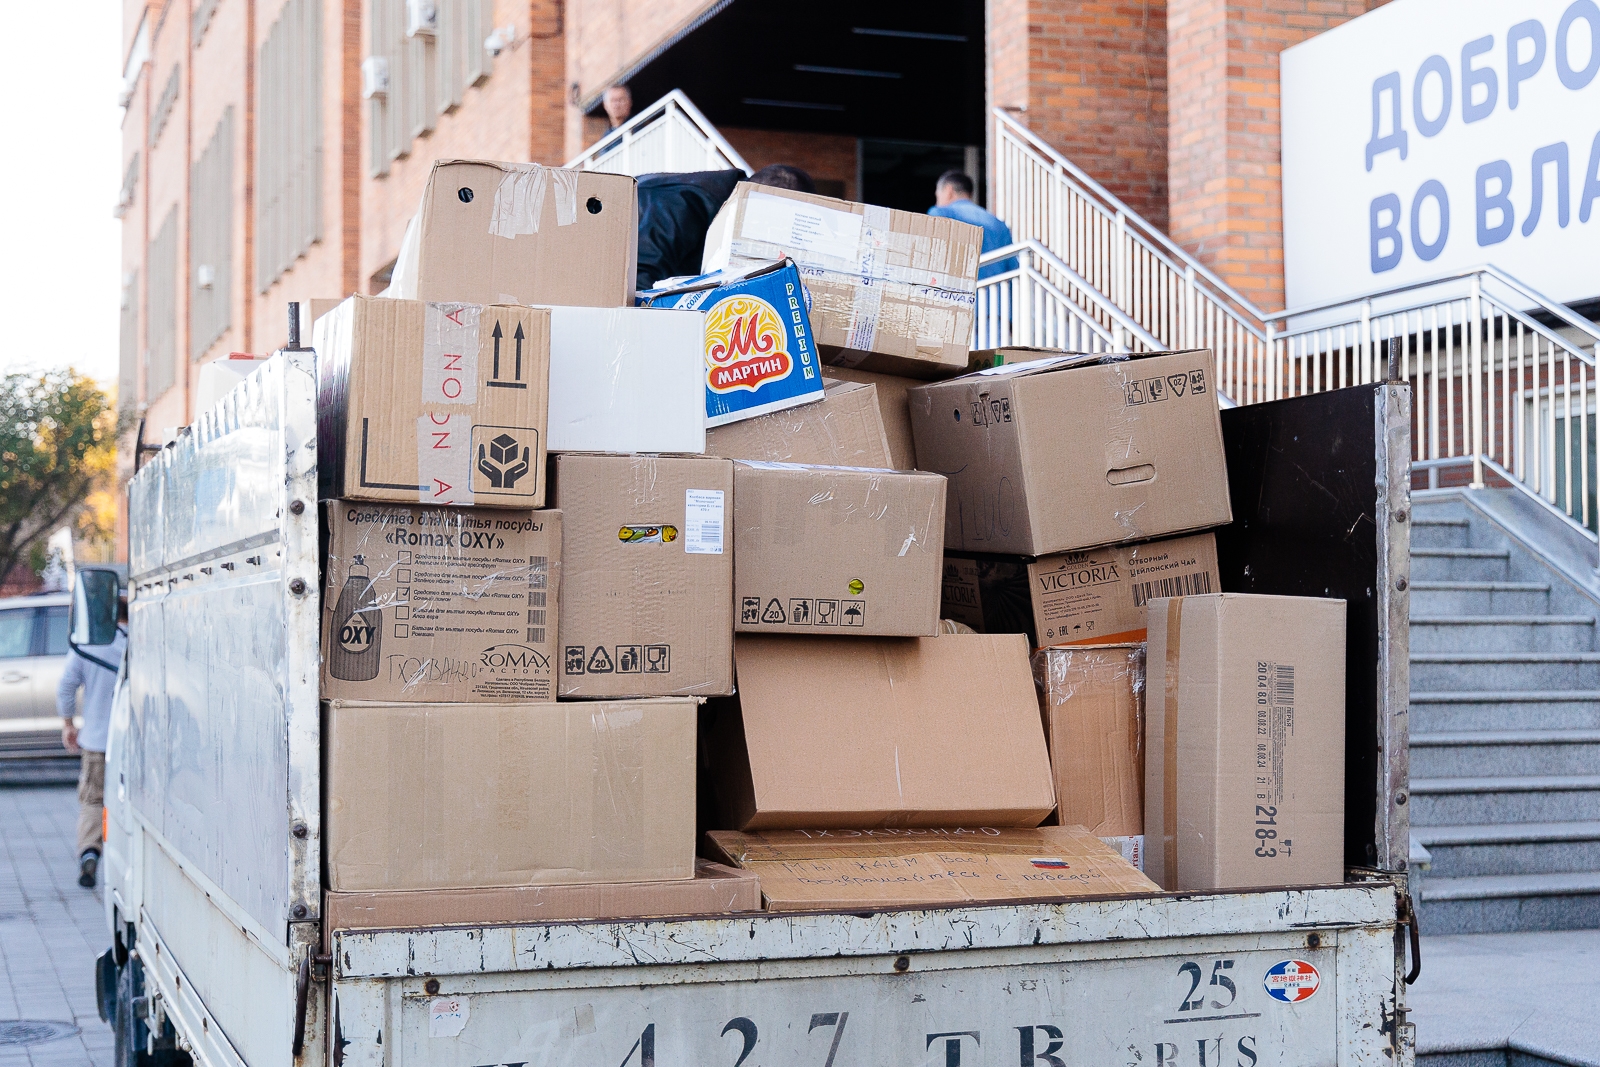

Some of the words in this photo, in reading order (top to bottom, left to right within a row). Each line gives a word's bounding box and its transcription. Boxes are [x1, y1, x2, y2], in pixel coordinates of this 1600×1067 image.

[1365, 0, 1600, 172] ДОБРО
[1370, 179, 1450, 274] ВО
[786, 283, 814, 380] PREMIUM
[717, 357, 782, 385] МАРТИН
[347, 509, 414, 526] Средство
[418, 511, 446, 528] для
[494, 518, 544, 536] посуды
[385, 528, 456, 548] «Romax
[459, 531, 505, 550] OXY»
[1040, 565, 1120, 591] VICTORIA
[770, 610, 779, 619] 20
[340, 626, 376, 644] OXY
[480, 651, 550, 668] ROMAX
[595, 660, 606, 668] 20
[1258, 662, 1267, 673] 20
[1255, 805, 1278, 858] 218-3
[1176, 959, 1237, 1013] 25
